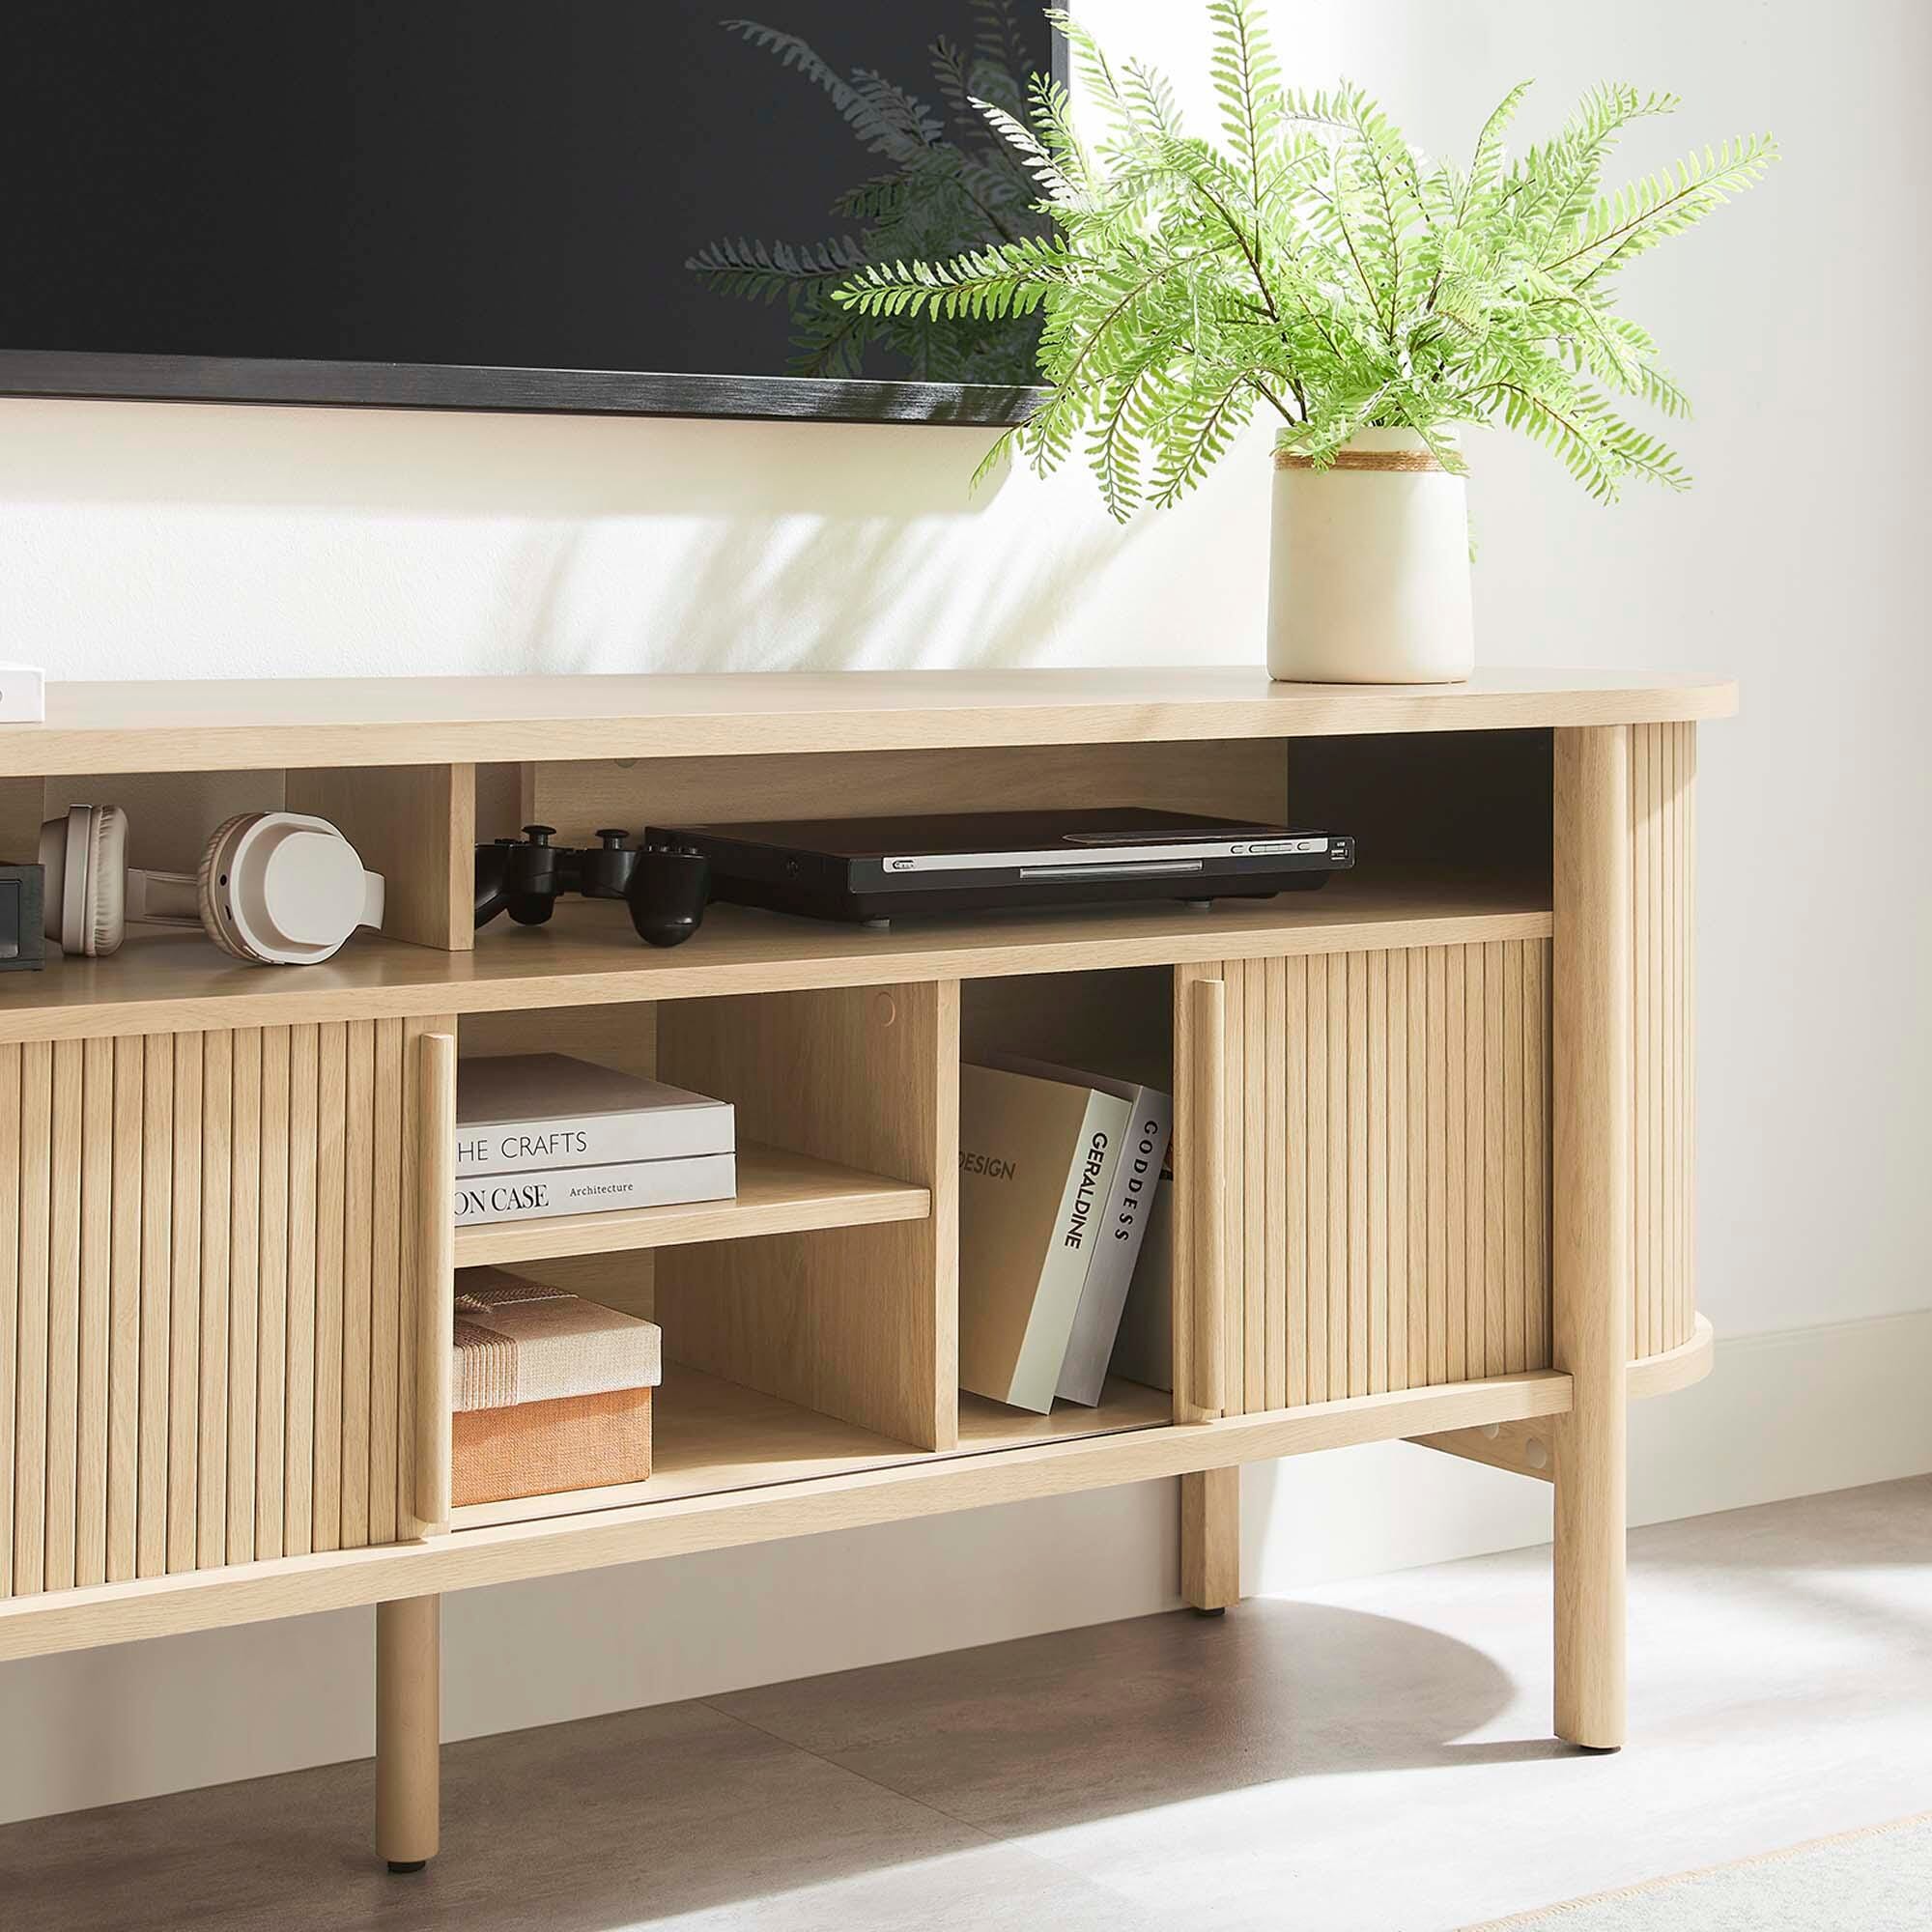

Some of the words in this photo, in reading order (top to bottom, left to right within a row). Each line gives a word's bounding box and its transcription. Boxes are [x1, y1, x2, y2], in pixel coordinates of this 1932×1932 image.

[500, 1131, 587, 1158] CRAFTS
[491, 1184, 550, 1211] CASE
[569, 1183, 634, 1197] Architecture
[1064, 1132, 1108, 1249] GERALDINE
